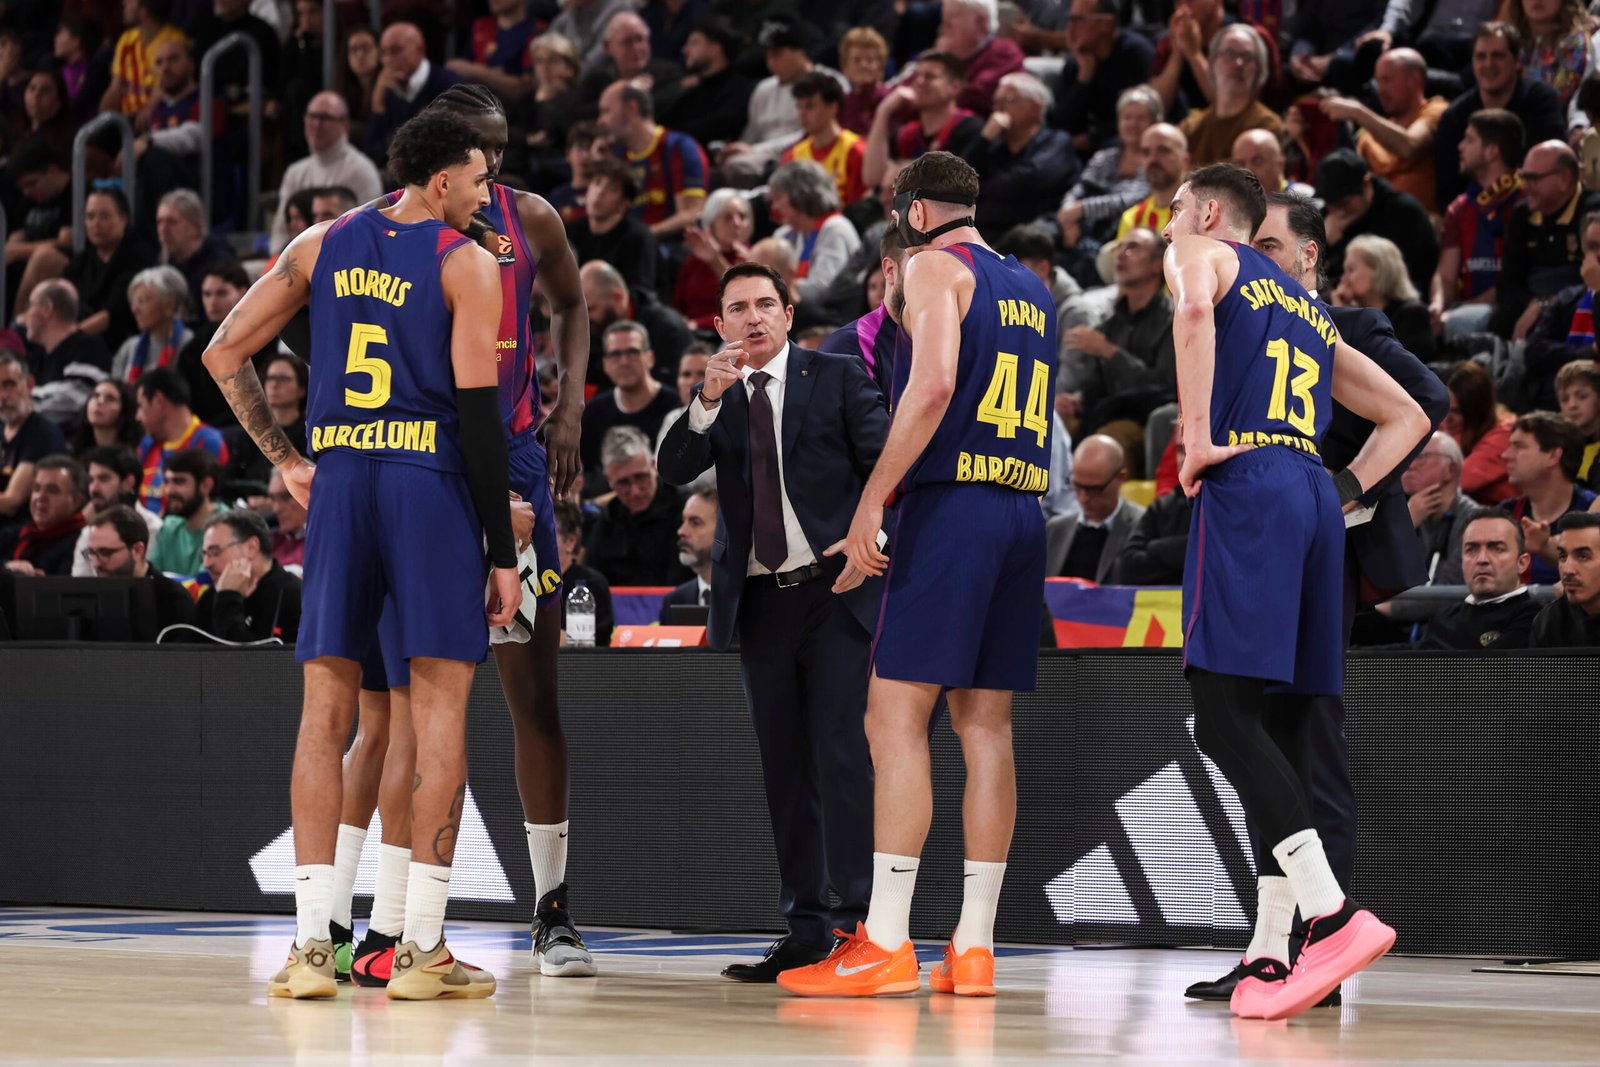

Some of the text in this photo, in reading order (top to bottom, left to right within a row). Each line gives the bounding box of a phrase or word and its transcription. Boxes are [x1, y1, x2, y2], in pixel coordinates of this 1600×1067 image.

[334, 267, 412, 307] NORRIS
[998, 299, 1046, 338] PARRA
[345, 322, 392, 409] 5
[1266, 337, 1320, 437] 13
[977, 351, 1049, 449] 44
[311, 419, 437, 453] BARCELONA
